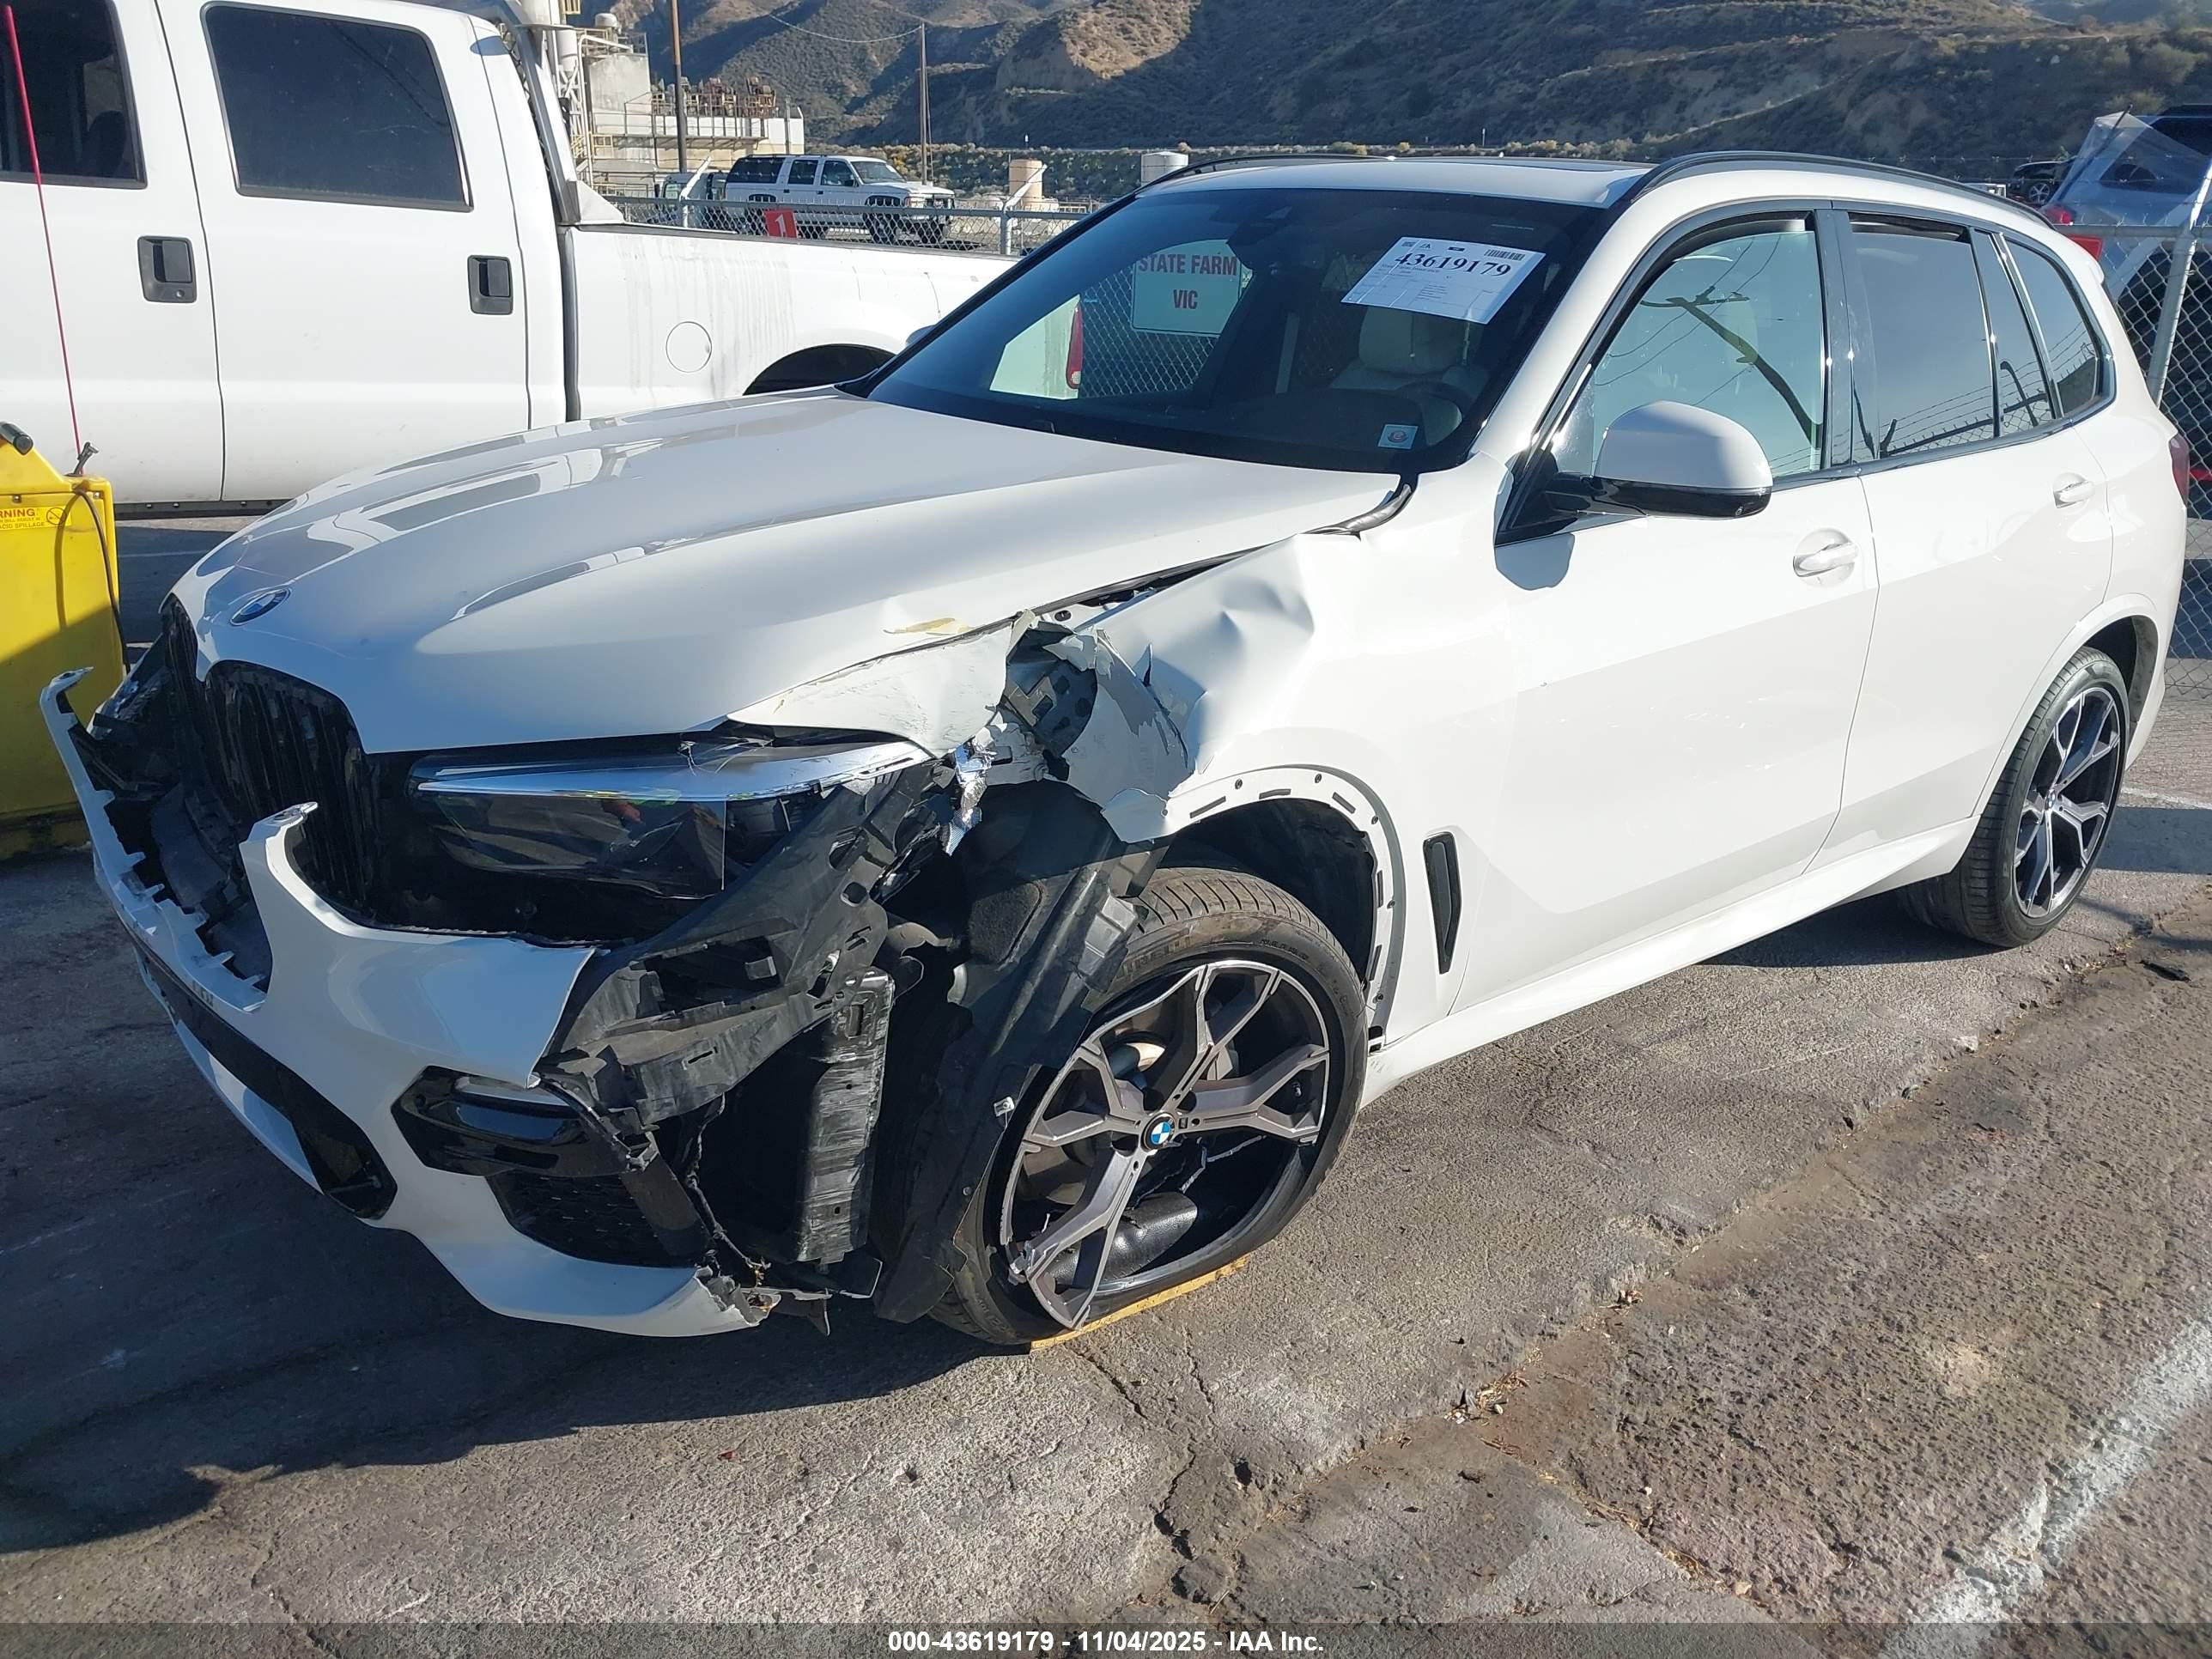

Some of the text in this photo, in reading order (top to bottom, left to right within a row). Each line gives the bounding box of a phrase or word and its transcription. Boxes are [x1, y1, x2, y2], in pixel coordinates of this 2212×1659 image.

[775, 214, 786, 237] 1
[1138, 253, 1237, 276] STATE FARM
[1395, 252, 1512, 277] 43619179
[1173, 289, 1199, 310] VIC
